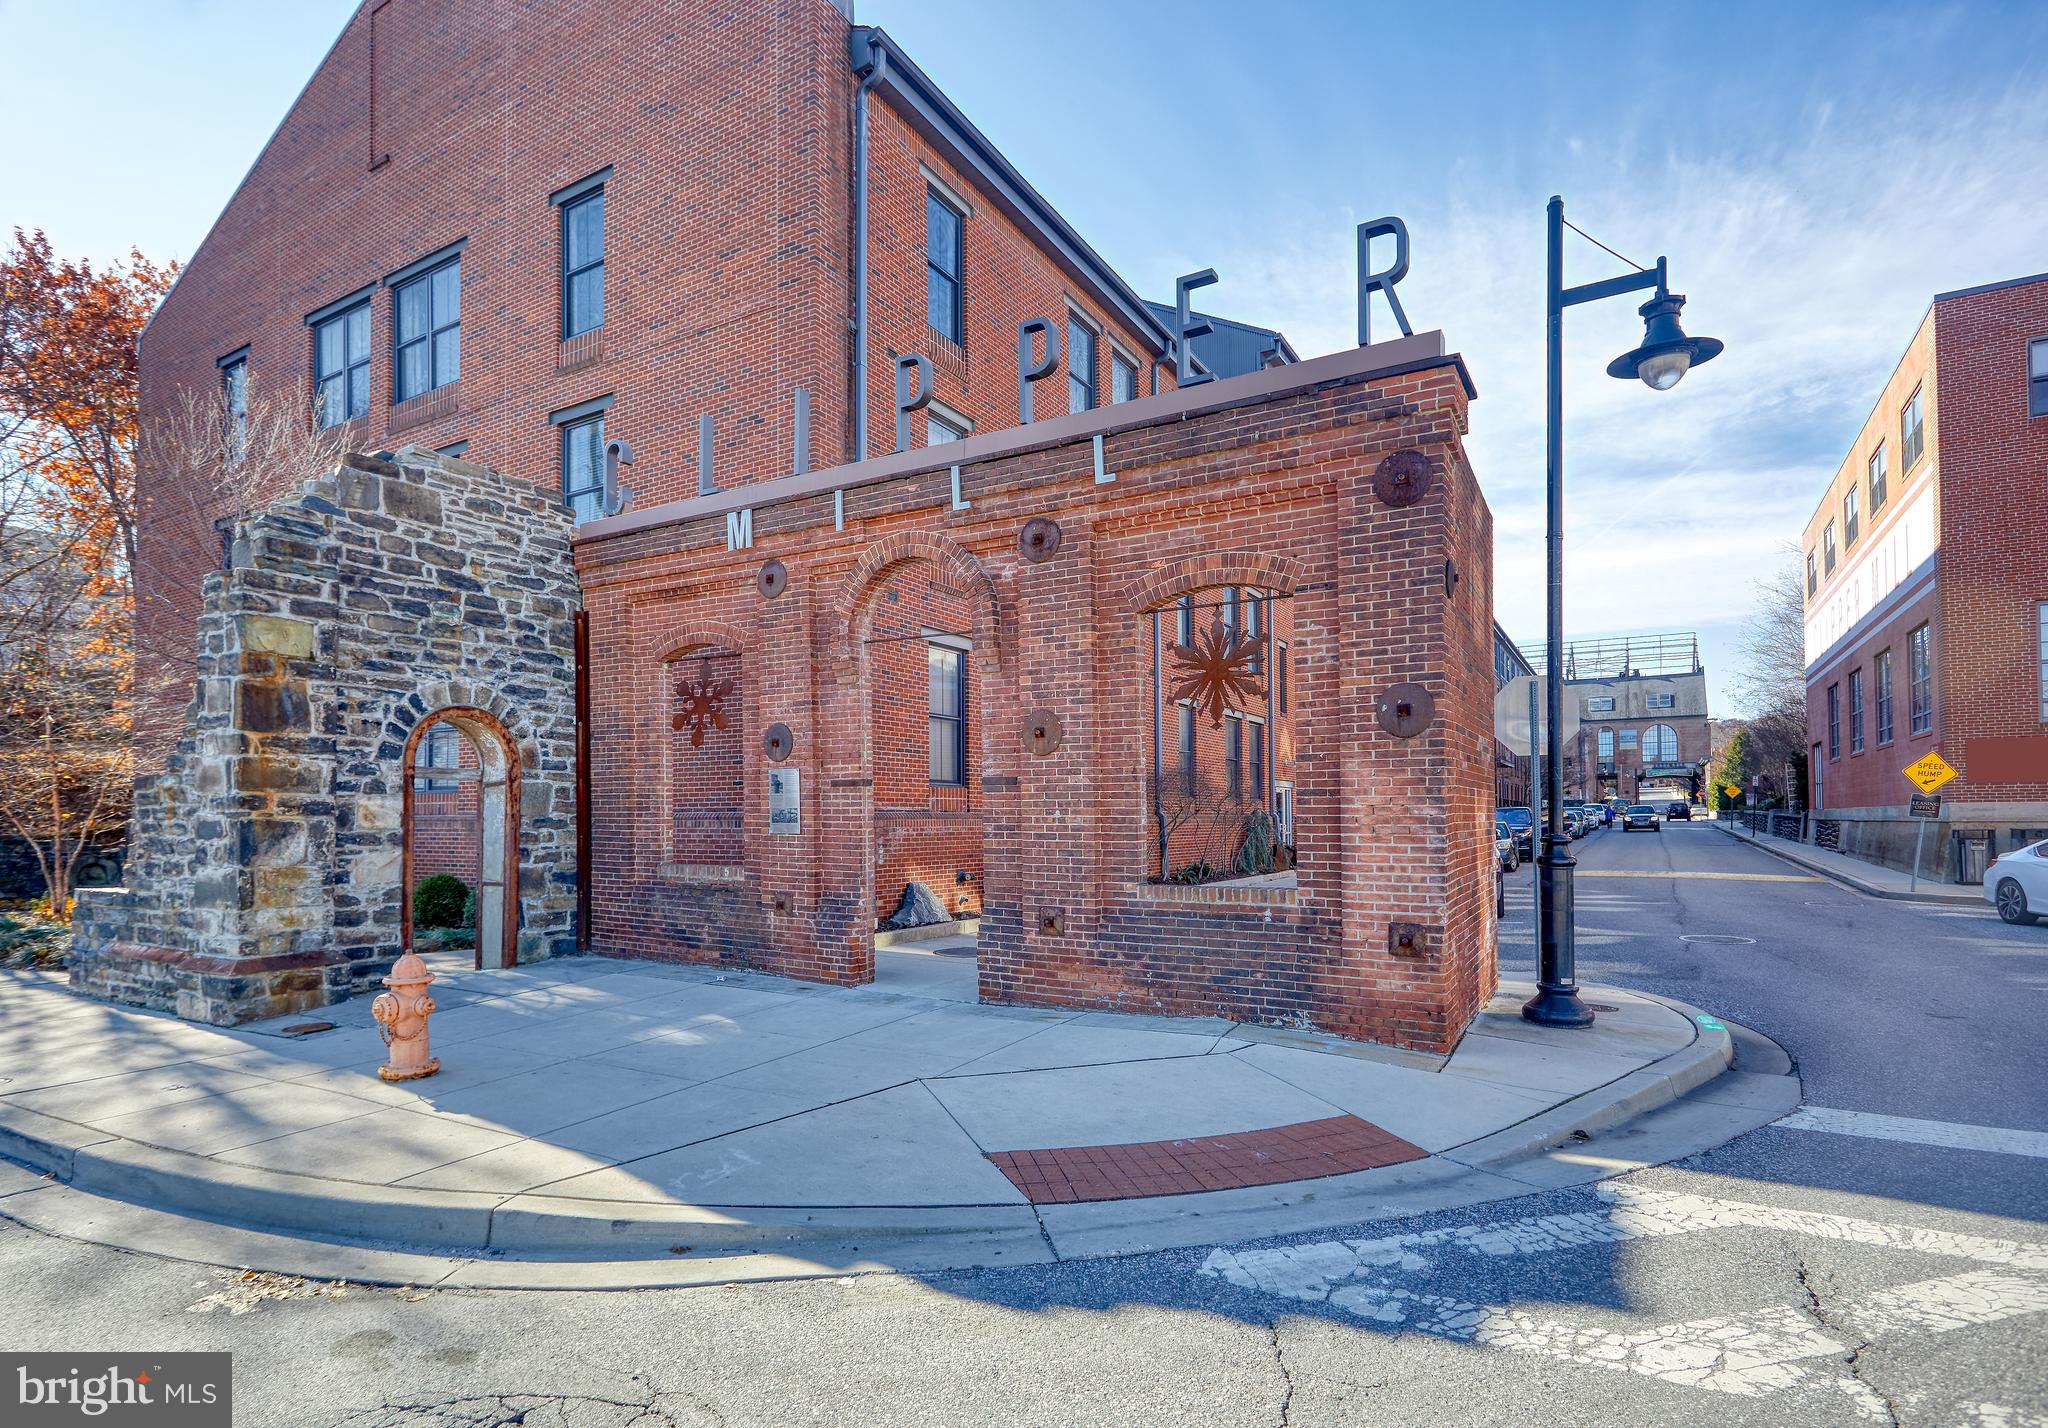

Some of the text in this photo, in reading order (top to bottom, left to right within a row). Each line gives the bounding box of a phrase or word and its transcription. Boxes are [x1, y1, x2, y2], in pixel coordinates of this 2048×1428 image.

[603, 216, 1411, 516] CLIPPER
[727, 434, 1117, 551] MILL
[1917, 762, 1945, 770] SPEED
